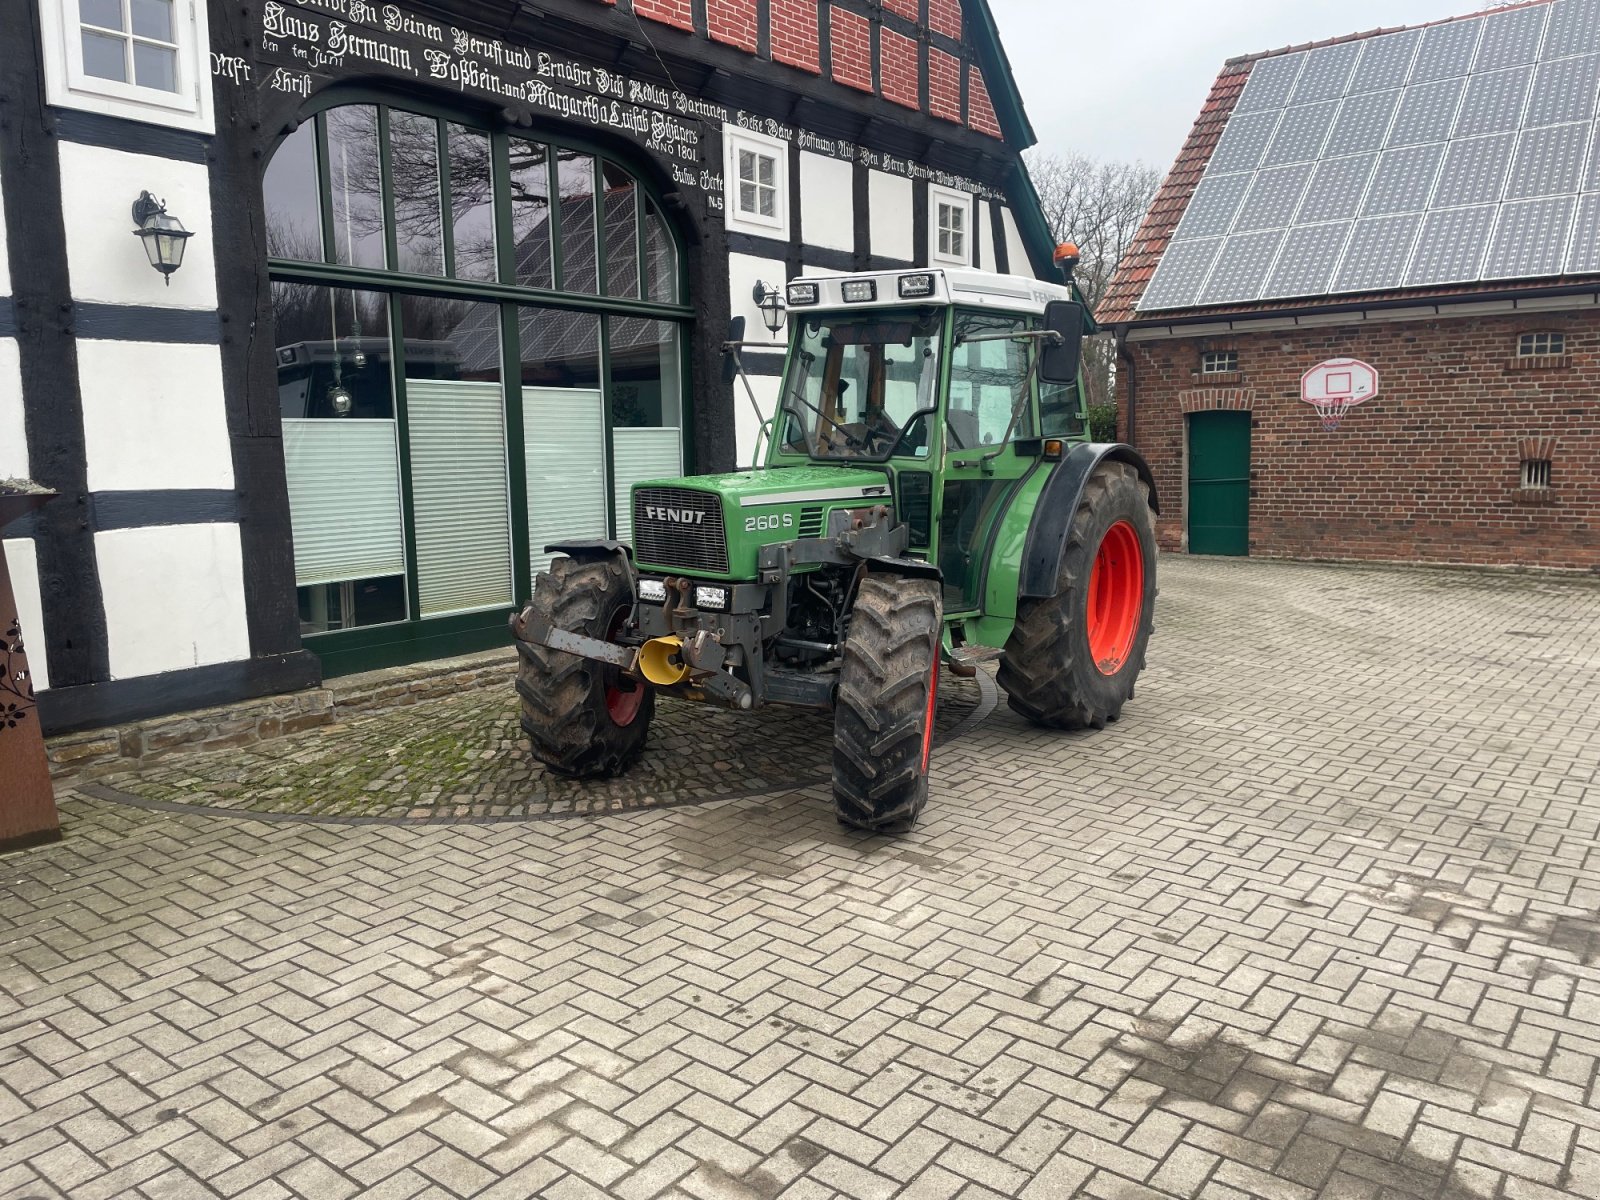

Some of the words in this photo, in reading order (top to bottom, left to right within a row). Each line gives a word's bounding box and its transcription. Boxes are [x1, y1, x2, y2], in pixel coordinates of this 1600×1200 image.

[505, 46, 531, 69] und
[593, 67, 624, 98] Dich
[645, 138, 674, 155] ANNO
[646, 506, 706, 525] FENDT
[744, 515, 780, 533] 260
[782, 513, 793, 528] S
